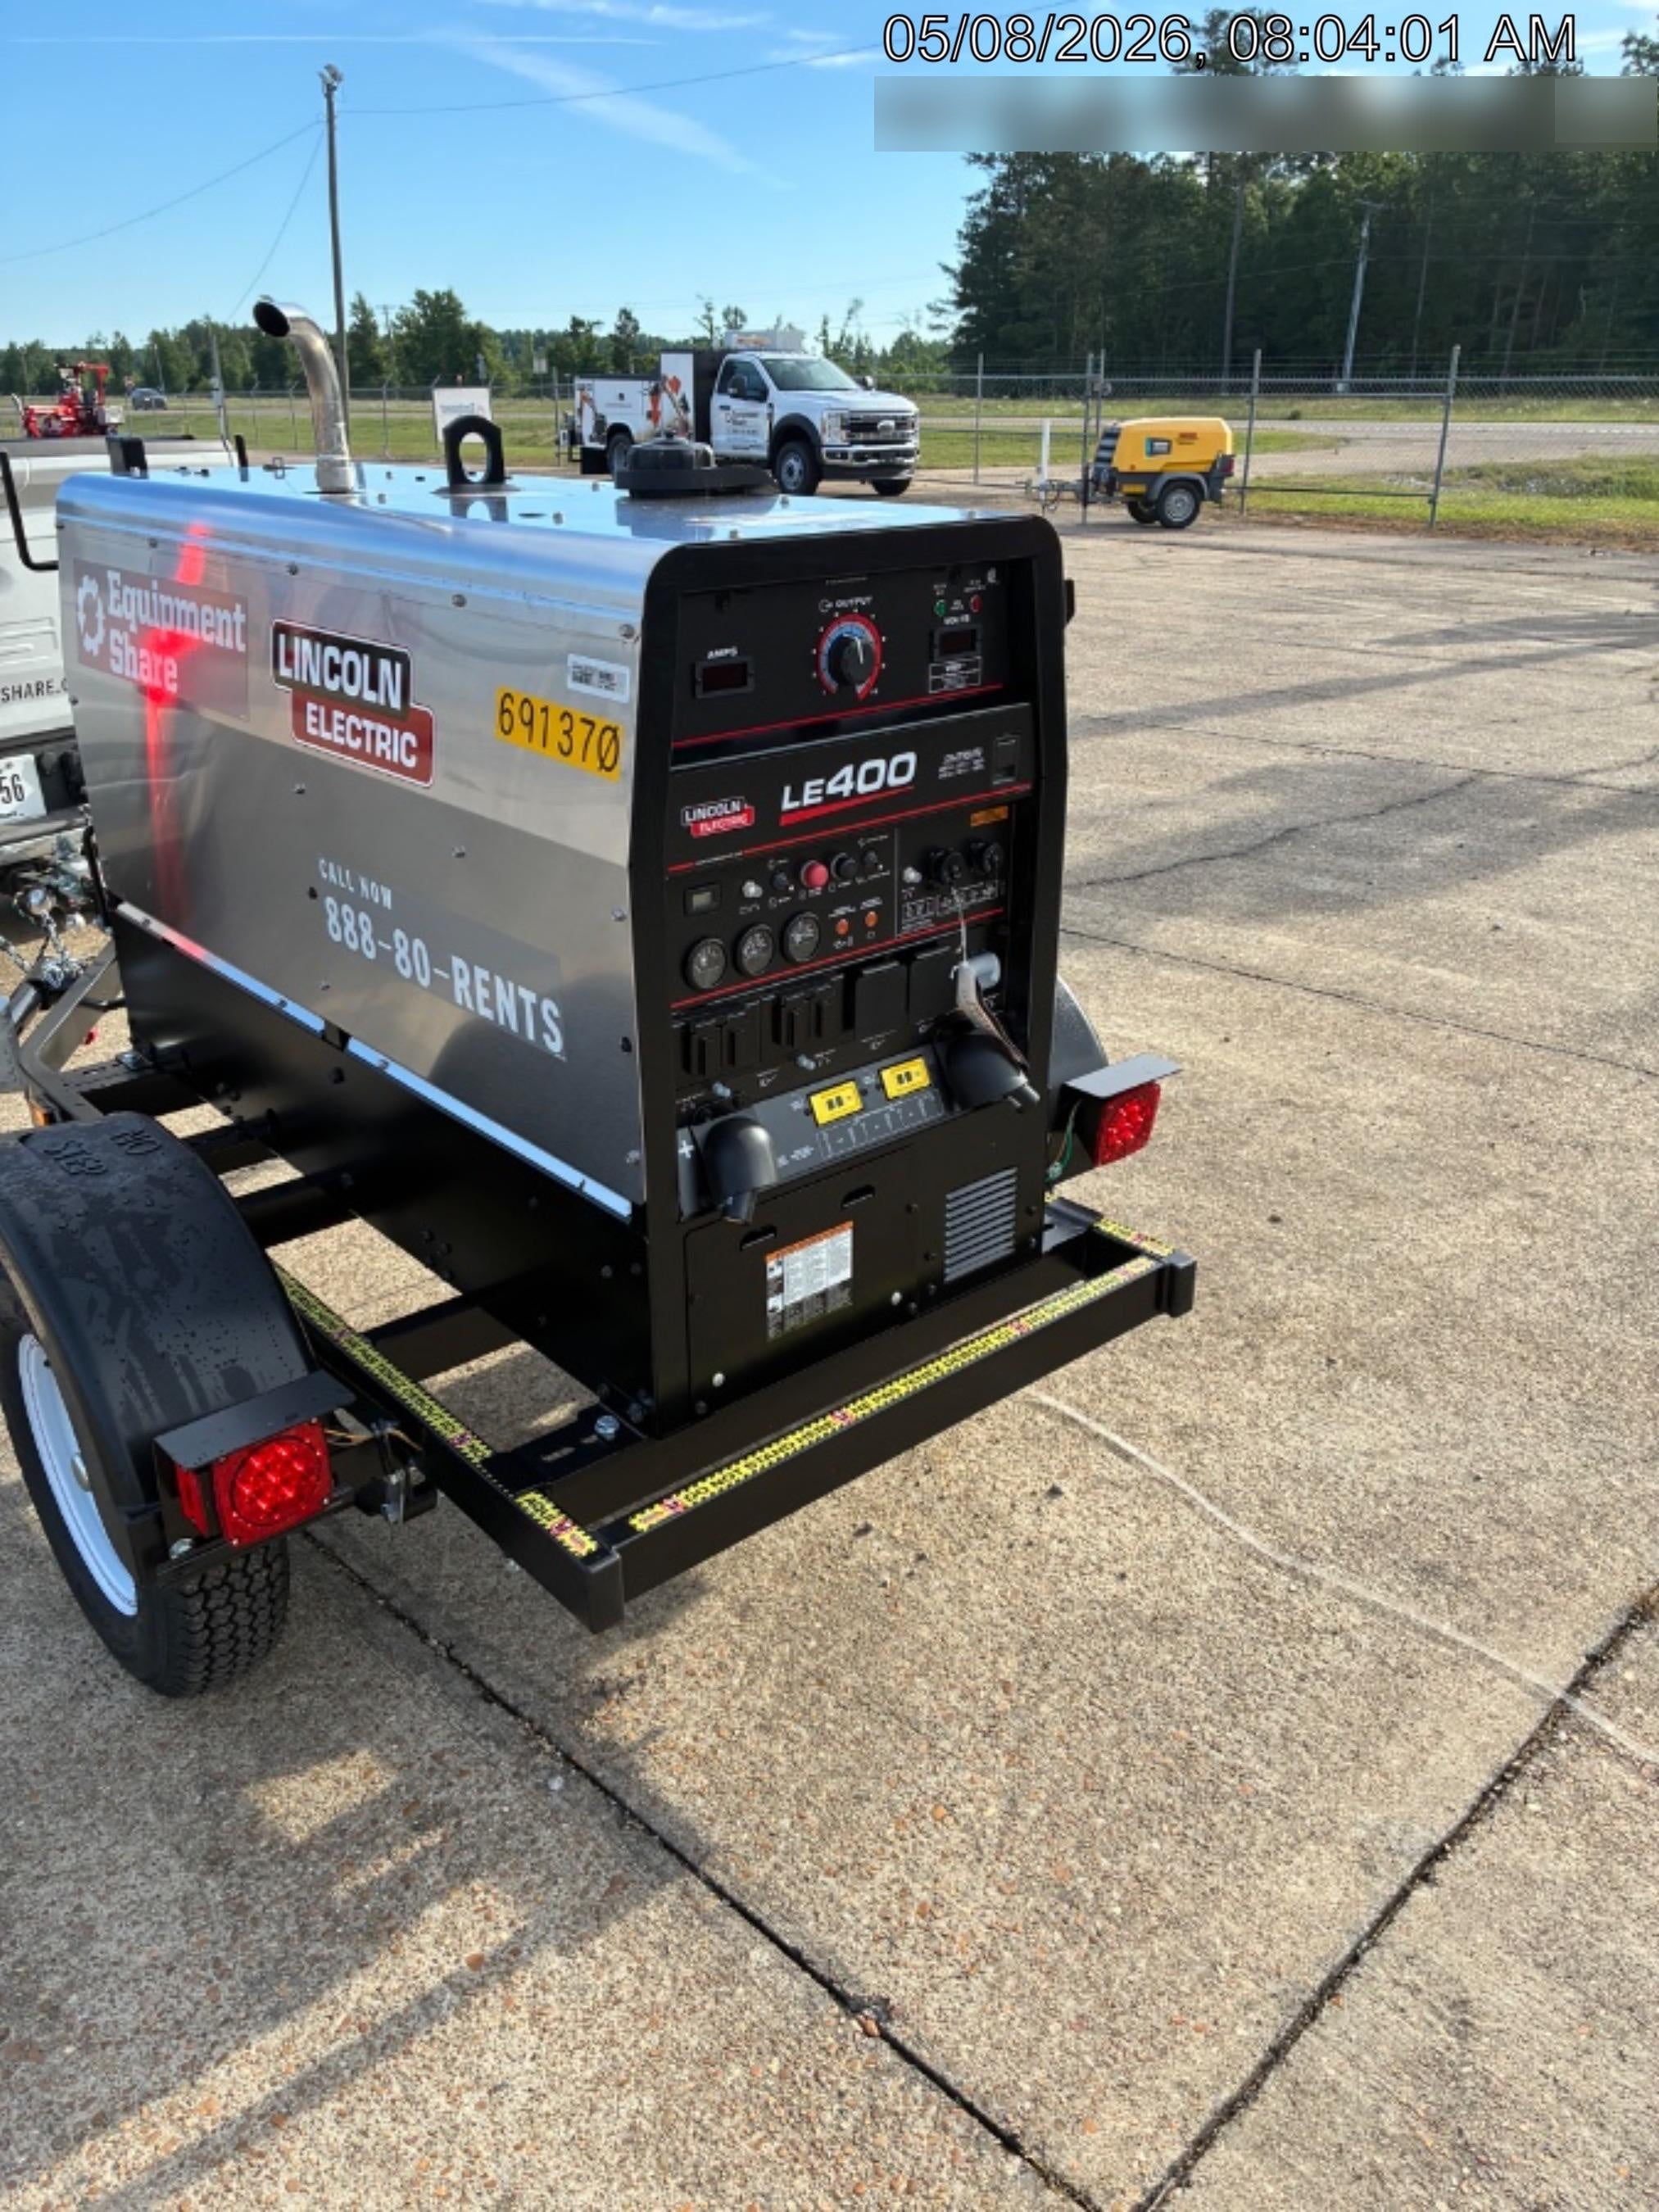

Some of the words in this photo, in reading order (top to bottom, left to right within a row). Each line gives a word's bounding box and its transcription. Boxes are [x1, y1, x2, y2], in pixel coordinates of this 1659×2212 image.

[107, 571, 247, 652] Equipment
[108, 628, 179, 692] Share
[278, 632, 402, 710] LINCOLN
[306, 702, 417, 768] ELECTRIC
[499, 692, 620, 773] 691370
[685, 800, 741, 823] LINCOLN
[781, 750, 917, 812] LE400
[318, 858, 355, 893] CALL
[359, 875, 392, 910] NOW
[324, 895, 564, 1054] 888-80-RENTS
